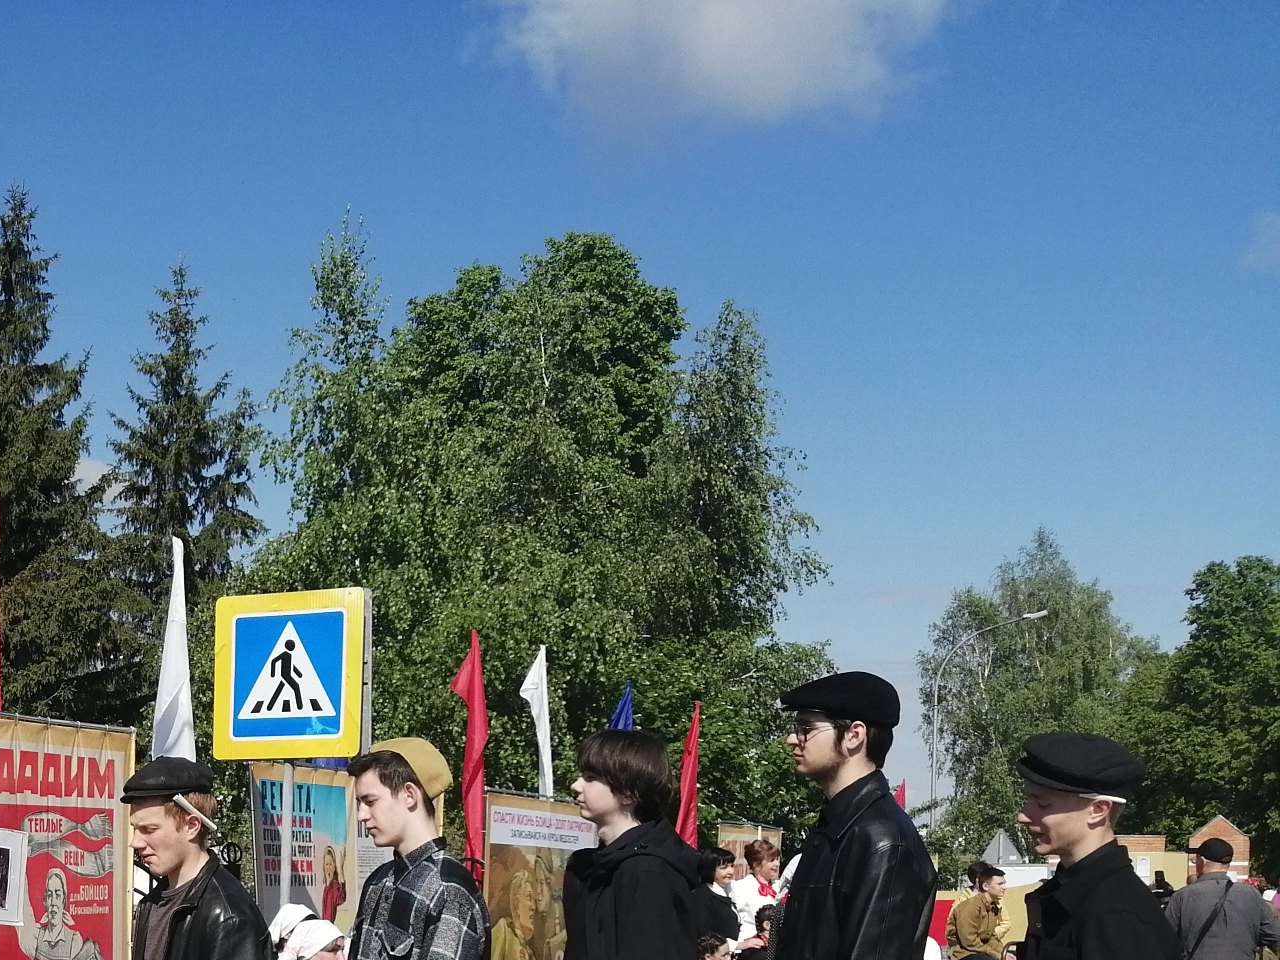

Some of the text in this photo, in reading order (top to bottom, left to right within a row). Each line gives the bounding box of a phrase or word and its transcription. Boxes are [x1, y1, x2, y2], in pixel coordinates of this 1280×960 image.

[260, 780, 316, 815] РЕТА,
[28, 817, 63, 833] ТЕПЛЫЕ
[262, 812, 312, 828] ЗАМНИМ
[64, 850, 85, 867] ВЕЩИ
[264, 859, 313, 872] ПОМЖЕМ
